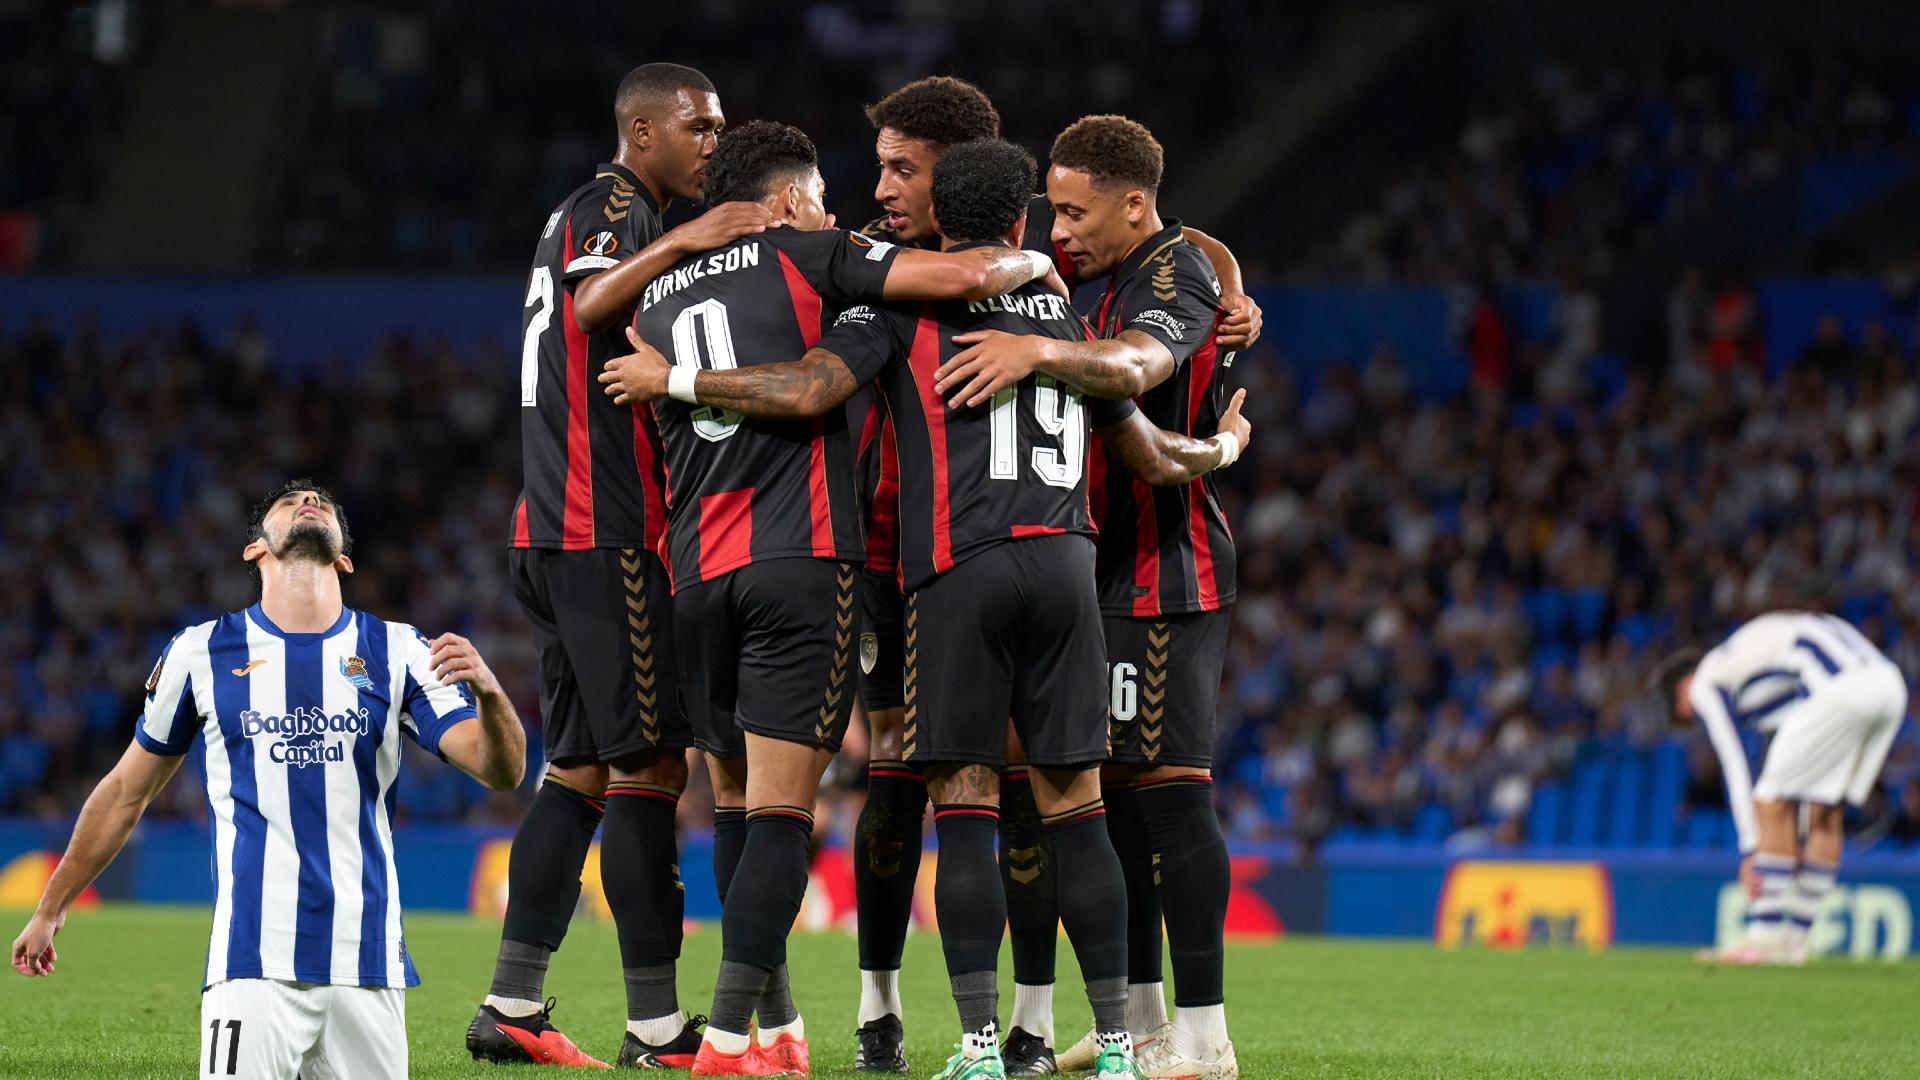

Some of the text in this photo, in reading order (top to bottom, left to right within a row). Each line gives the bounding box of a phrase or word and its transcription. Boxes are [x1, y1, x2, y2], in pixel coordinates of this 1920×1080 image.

[642, 242, 759, 312] EVANILSON
[989, 372, 1085, 490] 19
[1107, 662, 1138, 721] 6
[240, 707, 369, 740] Baghdadi
[269, 741, 344, 769] Capital
[208, 1018, 242, 1076] 11
